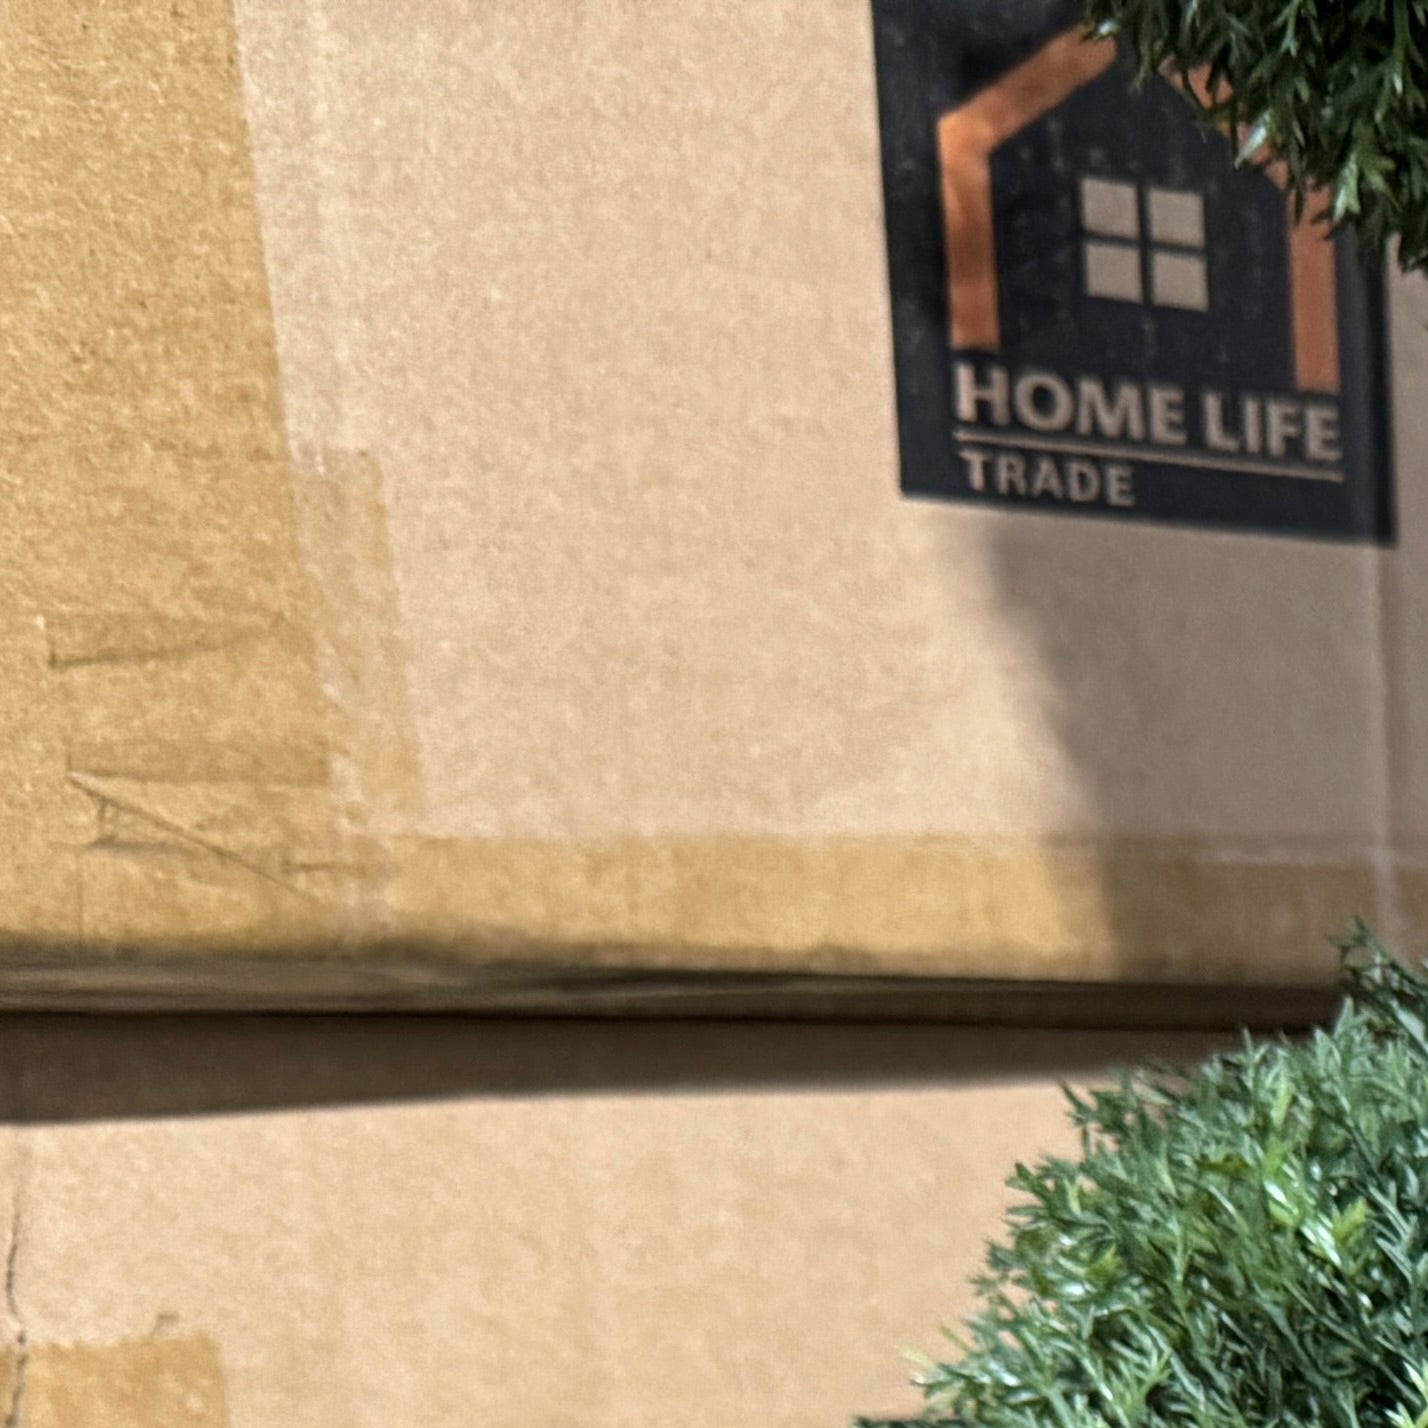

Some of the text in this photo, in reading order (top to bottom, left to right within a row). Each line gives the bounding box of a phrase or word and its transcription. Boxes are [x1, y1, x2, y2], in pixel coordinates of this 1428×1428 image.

[953, 361, 1344, 463] HOME LIFE
[959, 449, 1136, 507] TRADE
